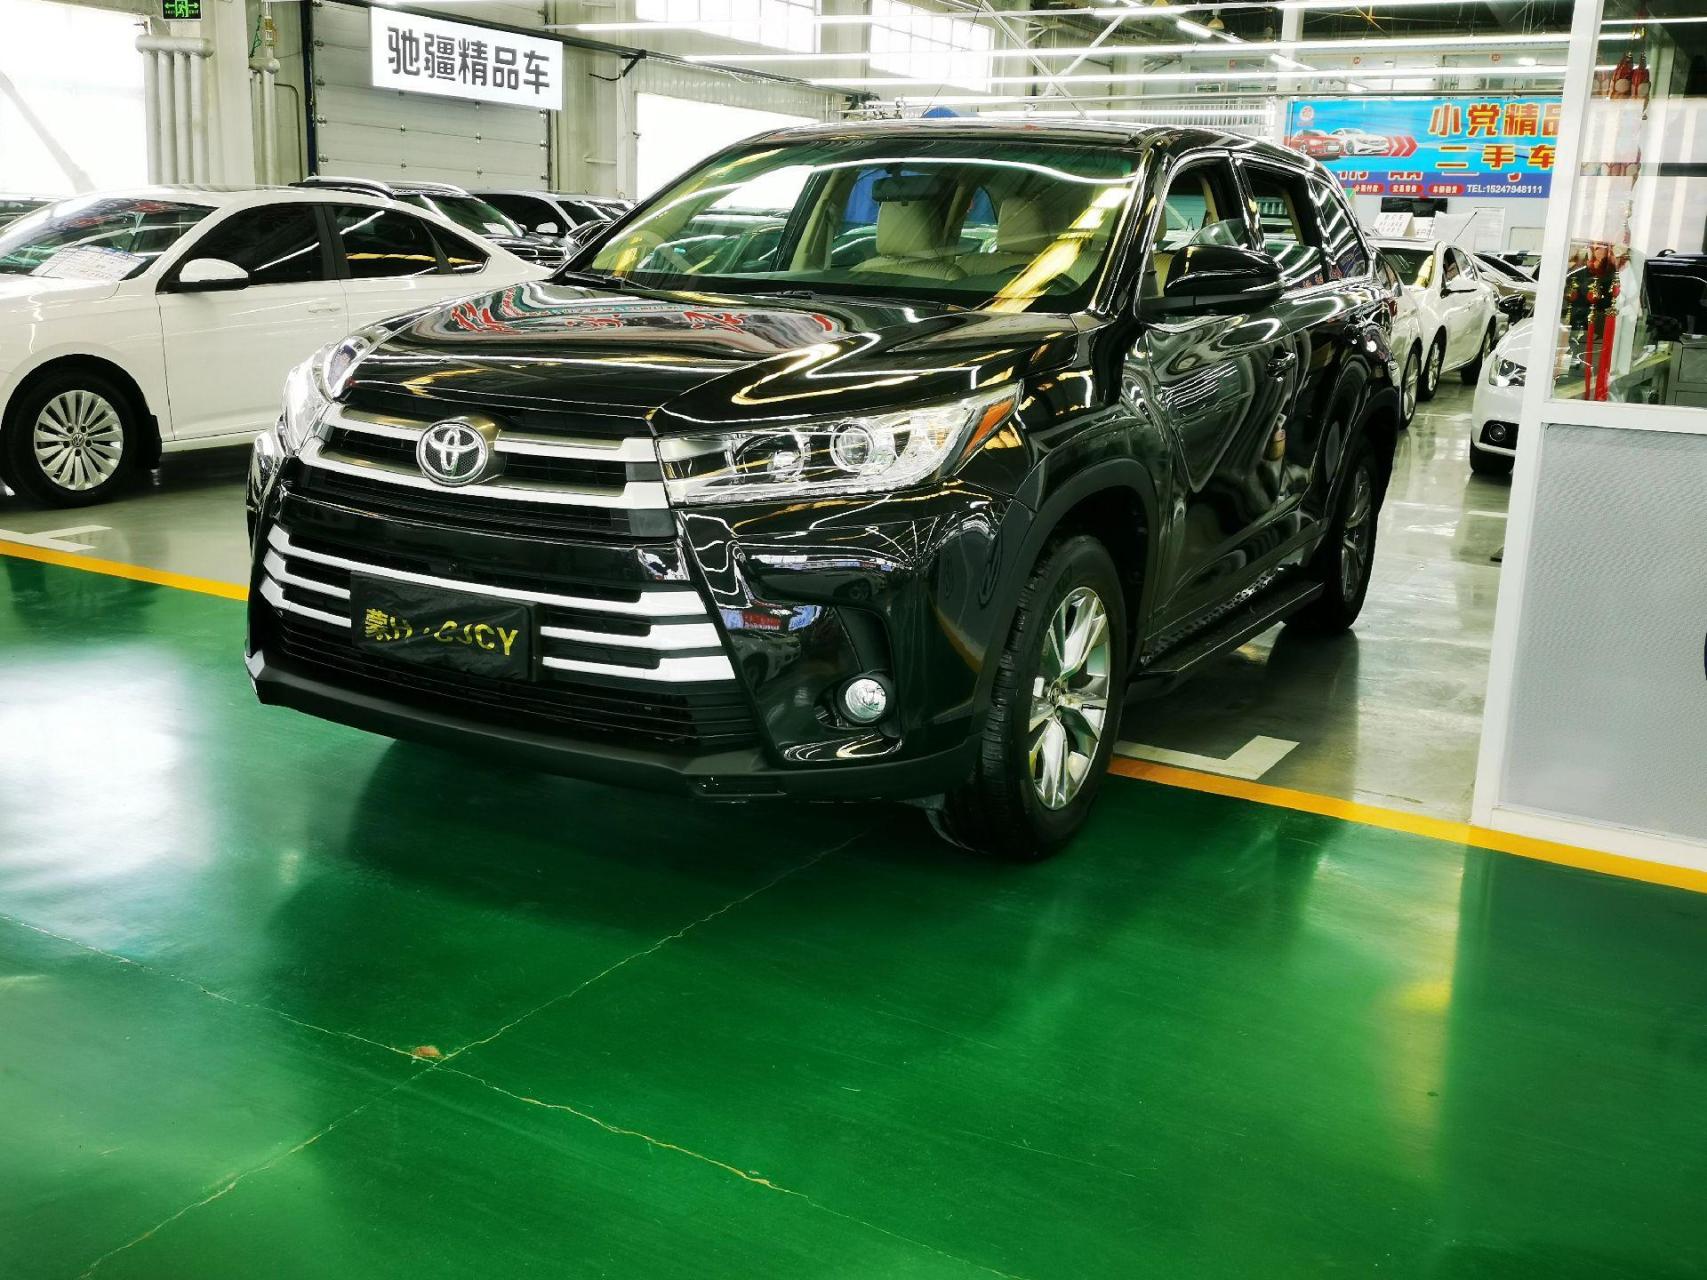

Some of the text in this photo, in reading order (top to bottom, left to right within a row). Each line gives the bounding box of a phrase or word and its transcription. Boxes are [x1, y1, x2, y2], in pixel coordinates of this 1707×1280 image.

[387, 26, 550, 95] 驰疆精品车
[1436, 145, 1555, 169] 二手车
